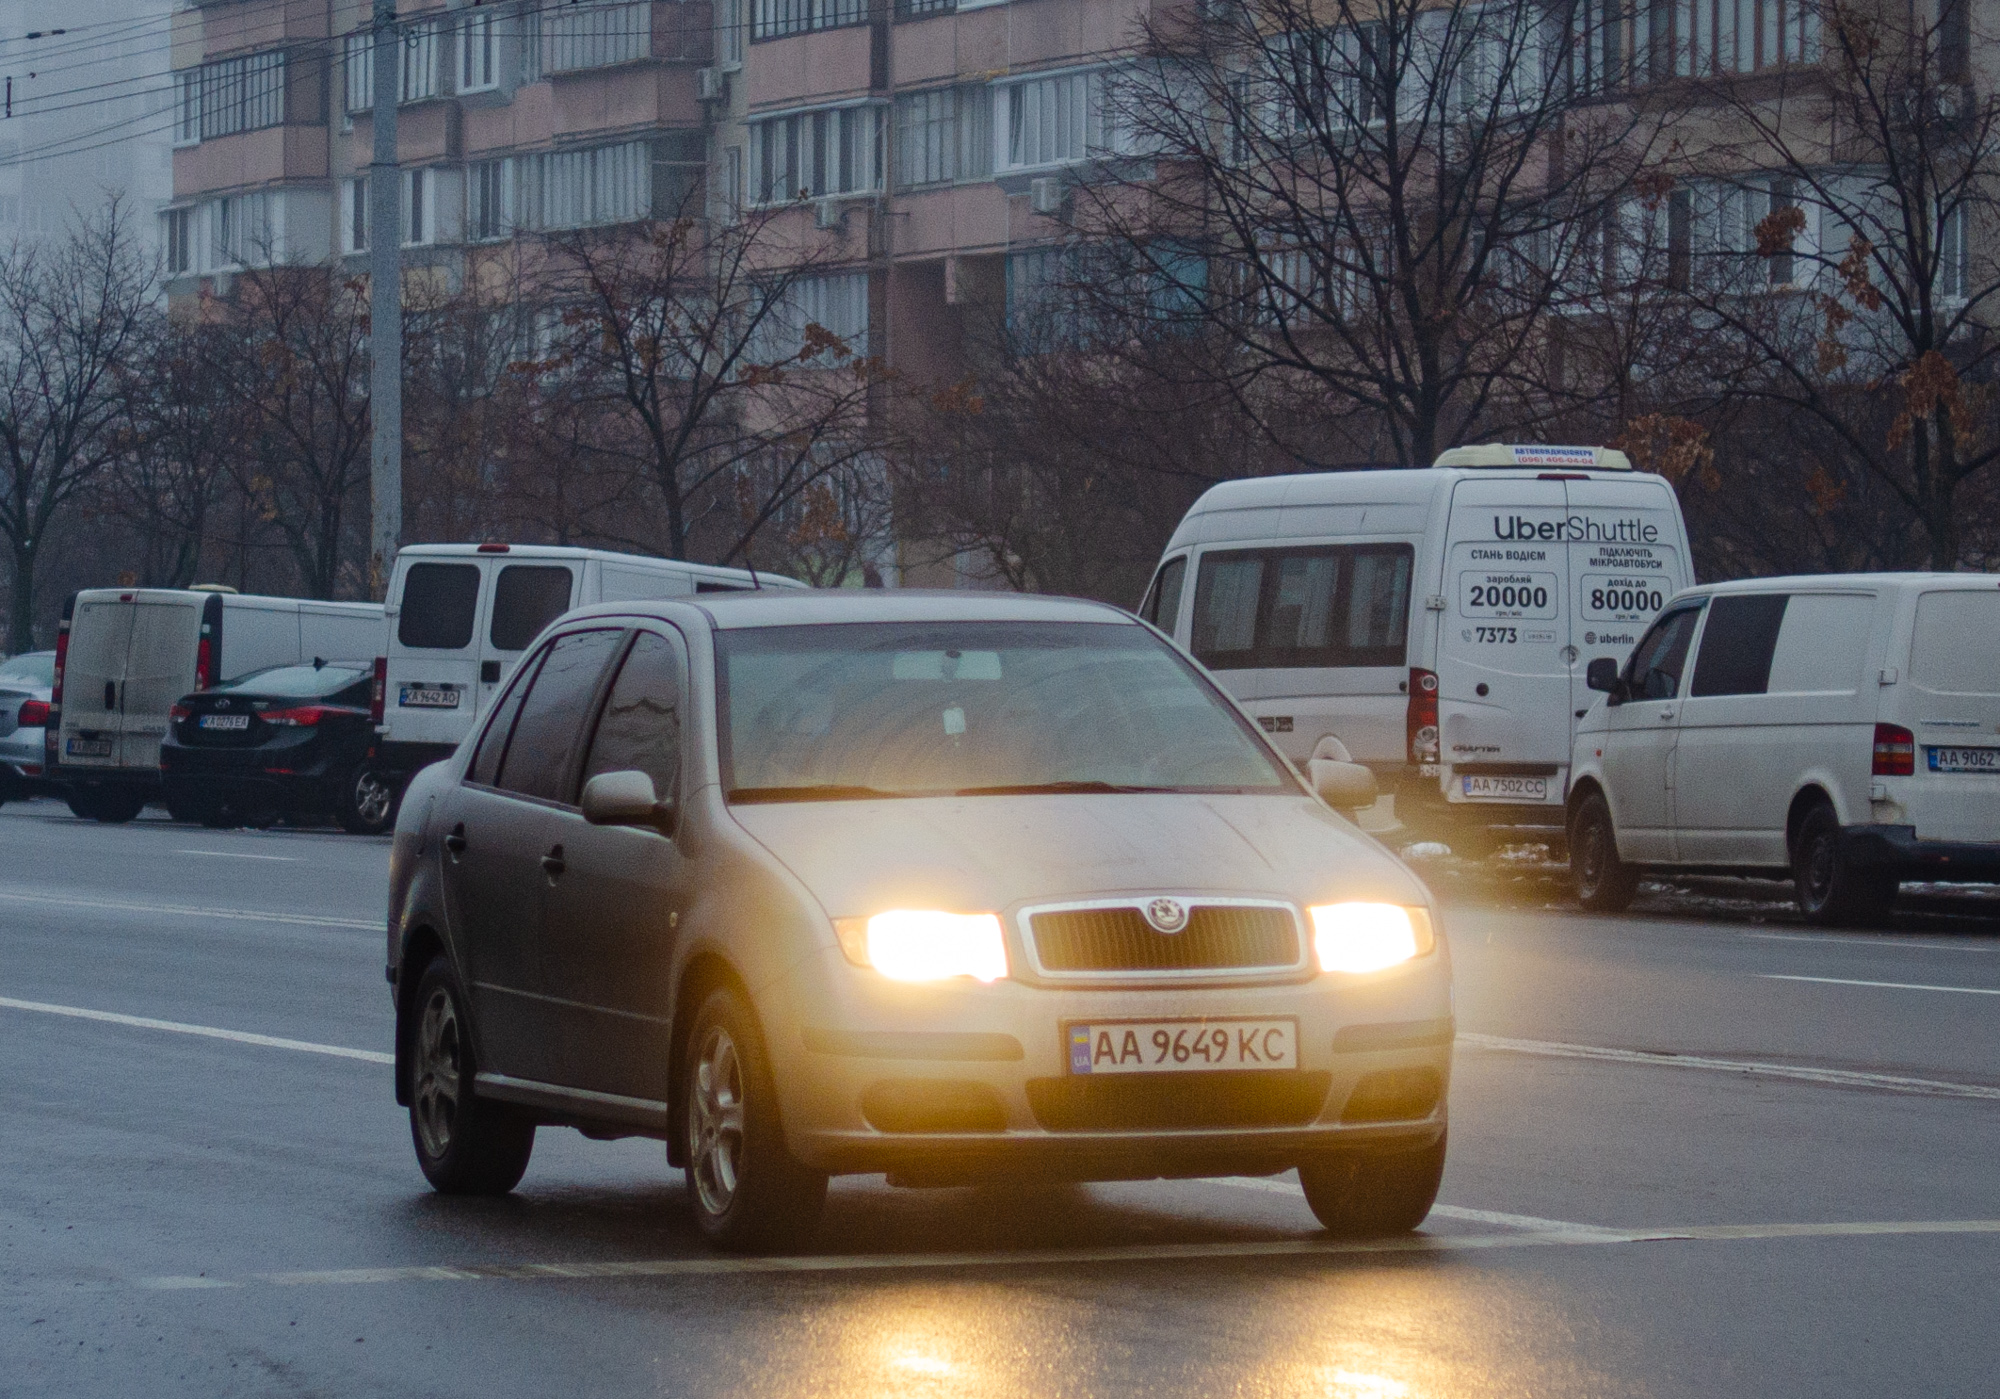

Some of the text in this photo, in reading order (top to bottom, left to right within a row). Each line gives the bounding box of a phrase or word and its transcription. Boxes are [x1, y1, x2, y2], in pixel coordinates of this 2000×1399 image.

[1471, 549, 1546, 562] СТАНЬ ВОДІЄМ
[1599, 547, 1653, 558] ПІДКЛЮЧІТЬ
[1589, 558, 1663, 569] МІКРОАВТОБУСИ
[1486, 575, 1532, 584] заробляй
[1607, 578, 1647, 588] дохід до
[1470, 585, 1548, 608] 20000
[1591, 588, 1663, 612] 80000
[1476, 627, 1518, 644] 7373
[1940, 751, 1995, 766] AA 9062
[1473, 778, 1544, 793] AA 7502 CC
[1094, 1028, 1285, 1065] AA 9649 KC
